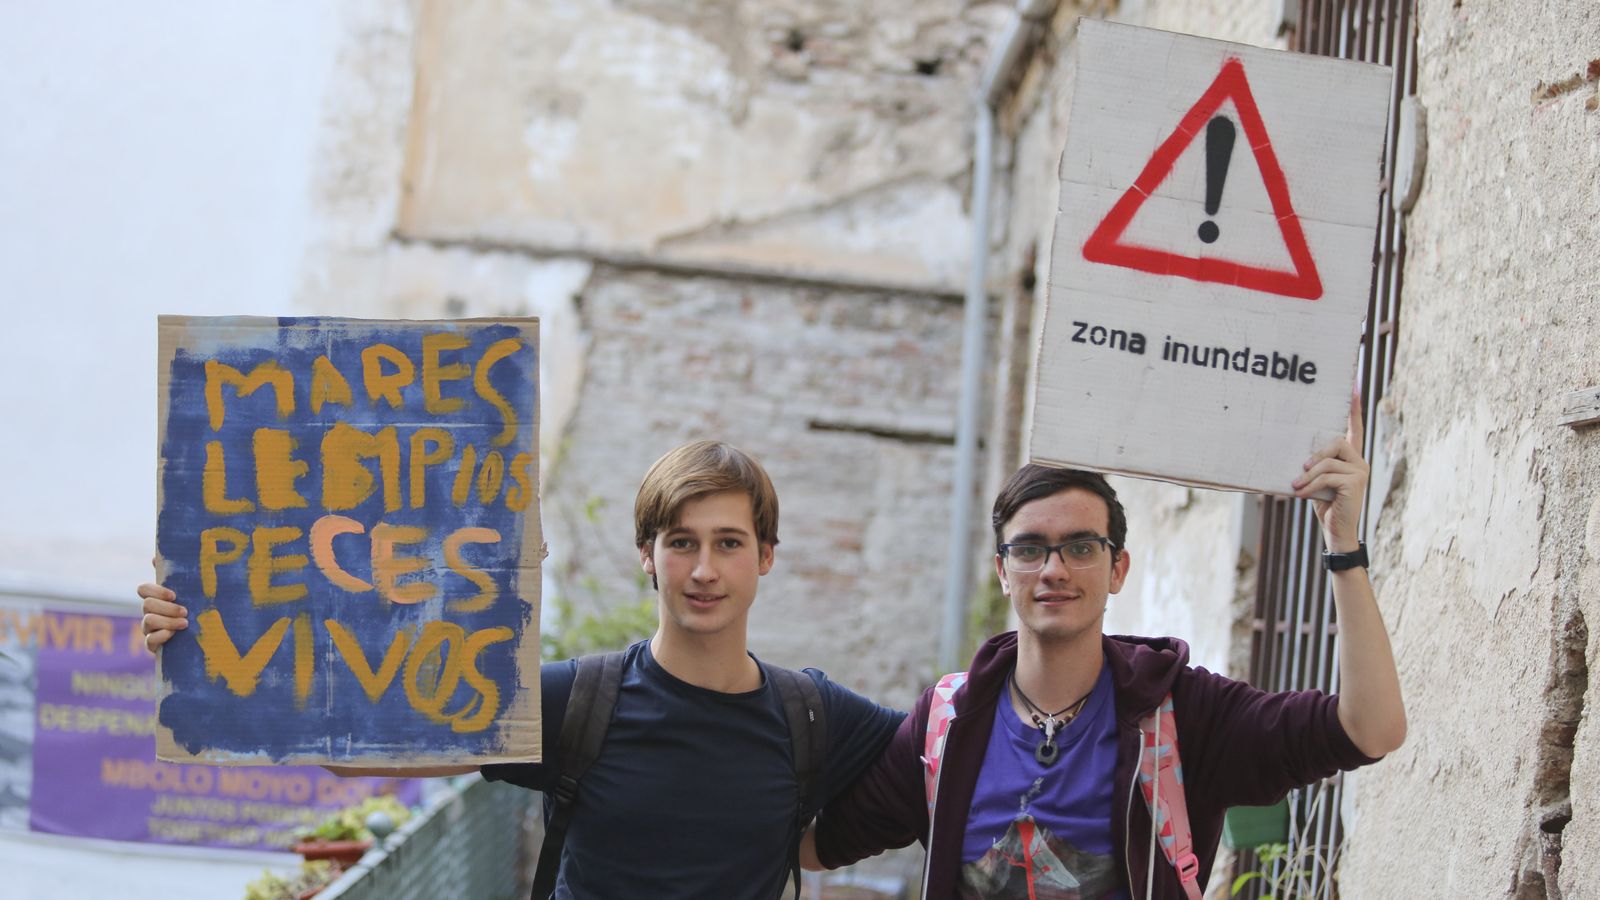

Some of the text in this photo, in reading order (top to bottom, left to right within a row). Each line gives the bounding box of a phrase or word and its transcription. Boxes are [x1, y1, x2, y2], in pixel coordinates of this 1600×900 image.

[204, 333, 522, 447] MARES
[1071, 320, 1318, 385] zona inundable
[200, 514, 502, 613] PECES
[197, 609, 515, 733] VIVOS
